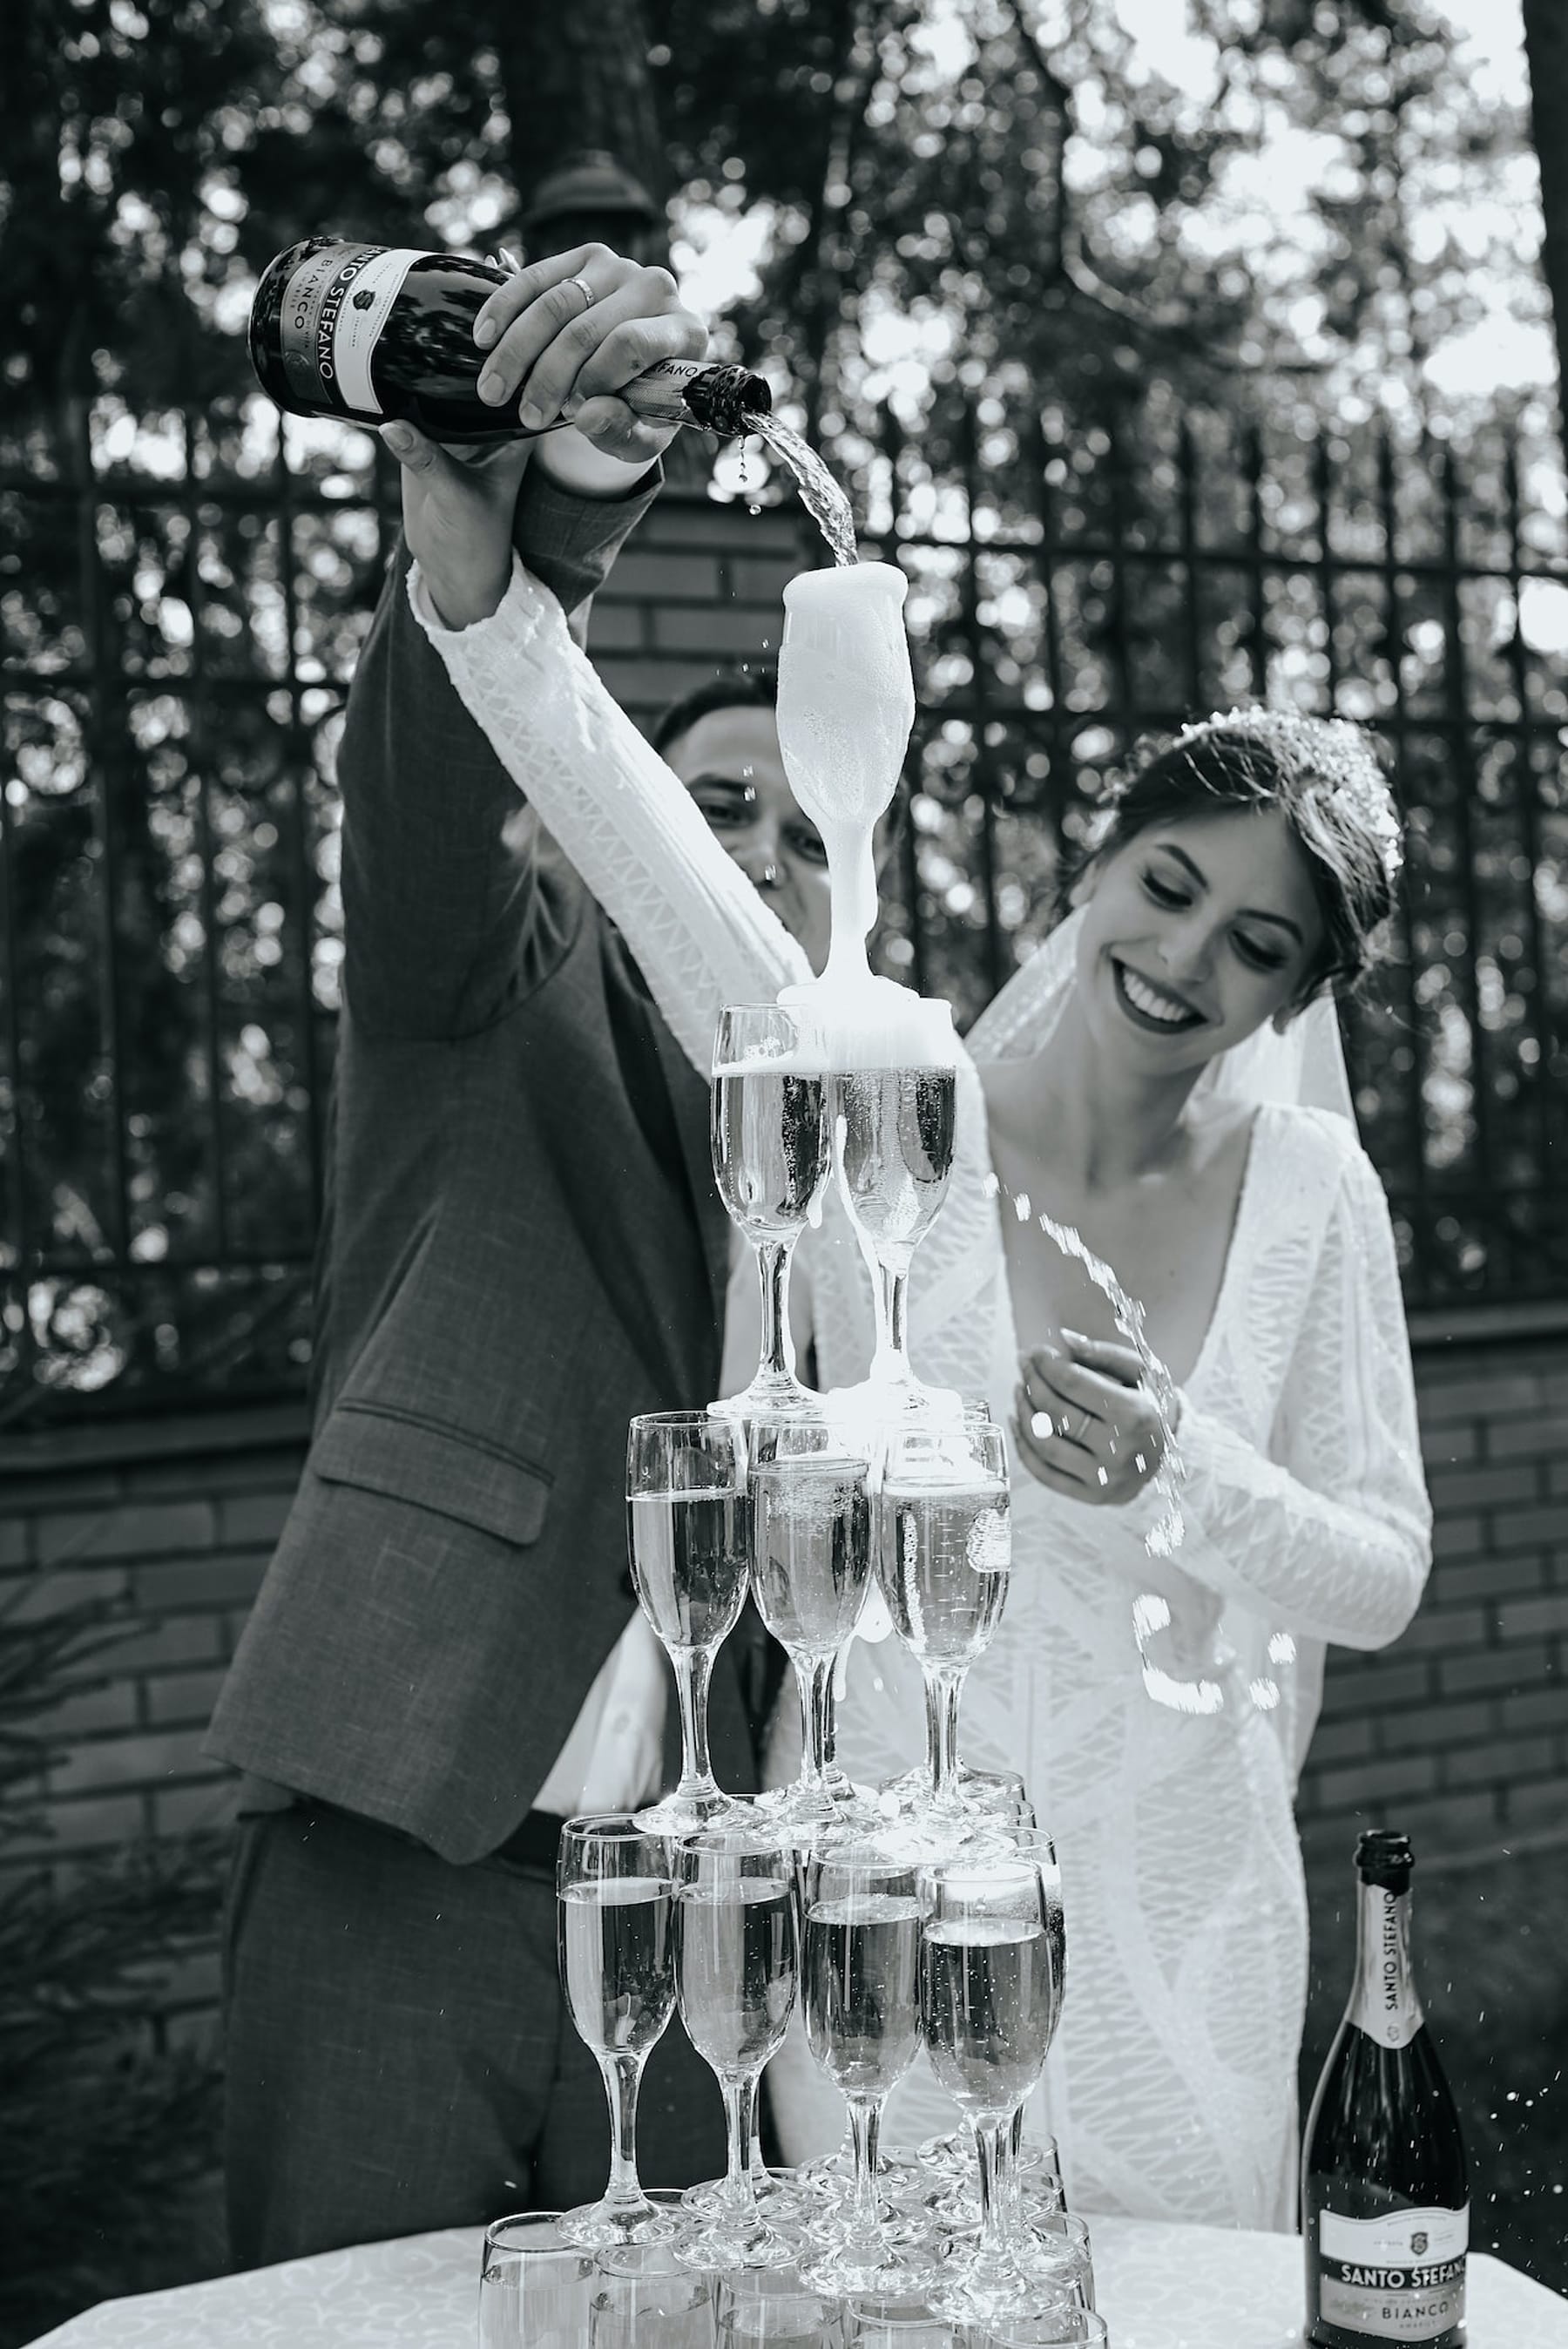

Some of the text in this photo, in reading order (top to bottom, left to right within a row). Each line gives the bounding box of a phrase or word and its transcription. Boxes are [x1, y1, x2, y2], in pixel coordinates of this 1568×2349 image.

[294, 259, 334, 329] BIANCO
[318, 286, 345, 380] STEFANO
[657, 362, 698, 377] FANO
[1383, 1892, 1399, 2011] SANTO STEFANO
[1341, 2263, 1405, 2289] SANTO
[1410, 2259, 1466, 2288] STEFAN
[1382, 2300, 1450, 2320] BIANCO
